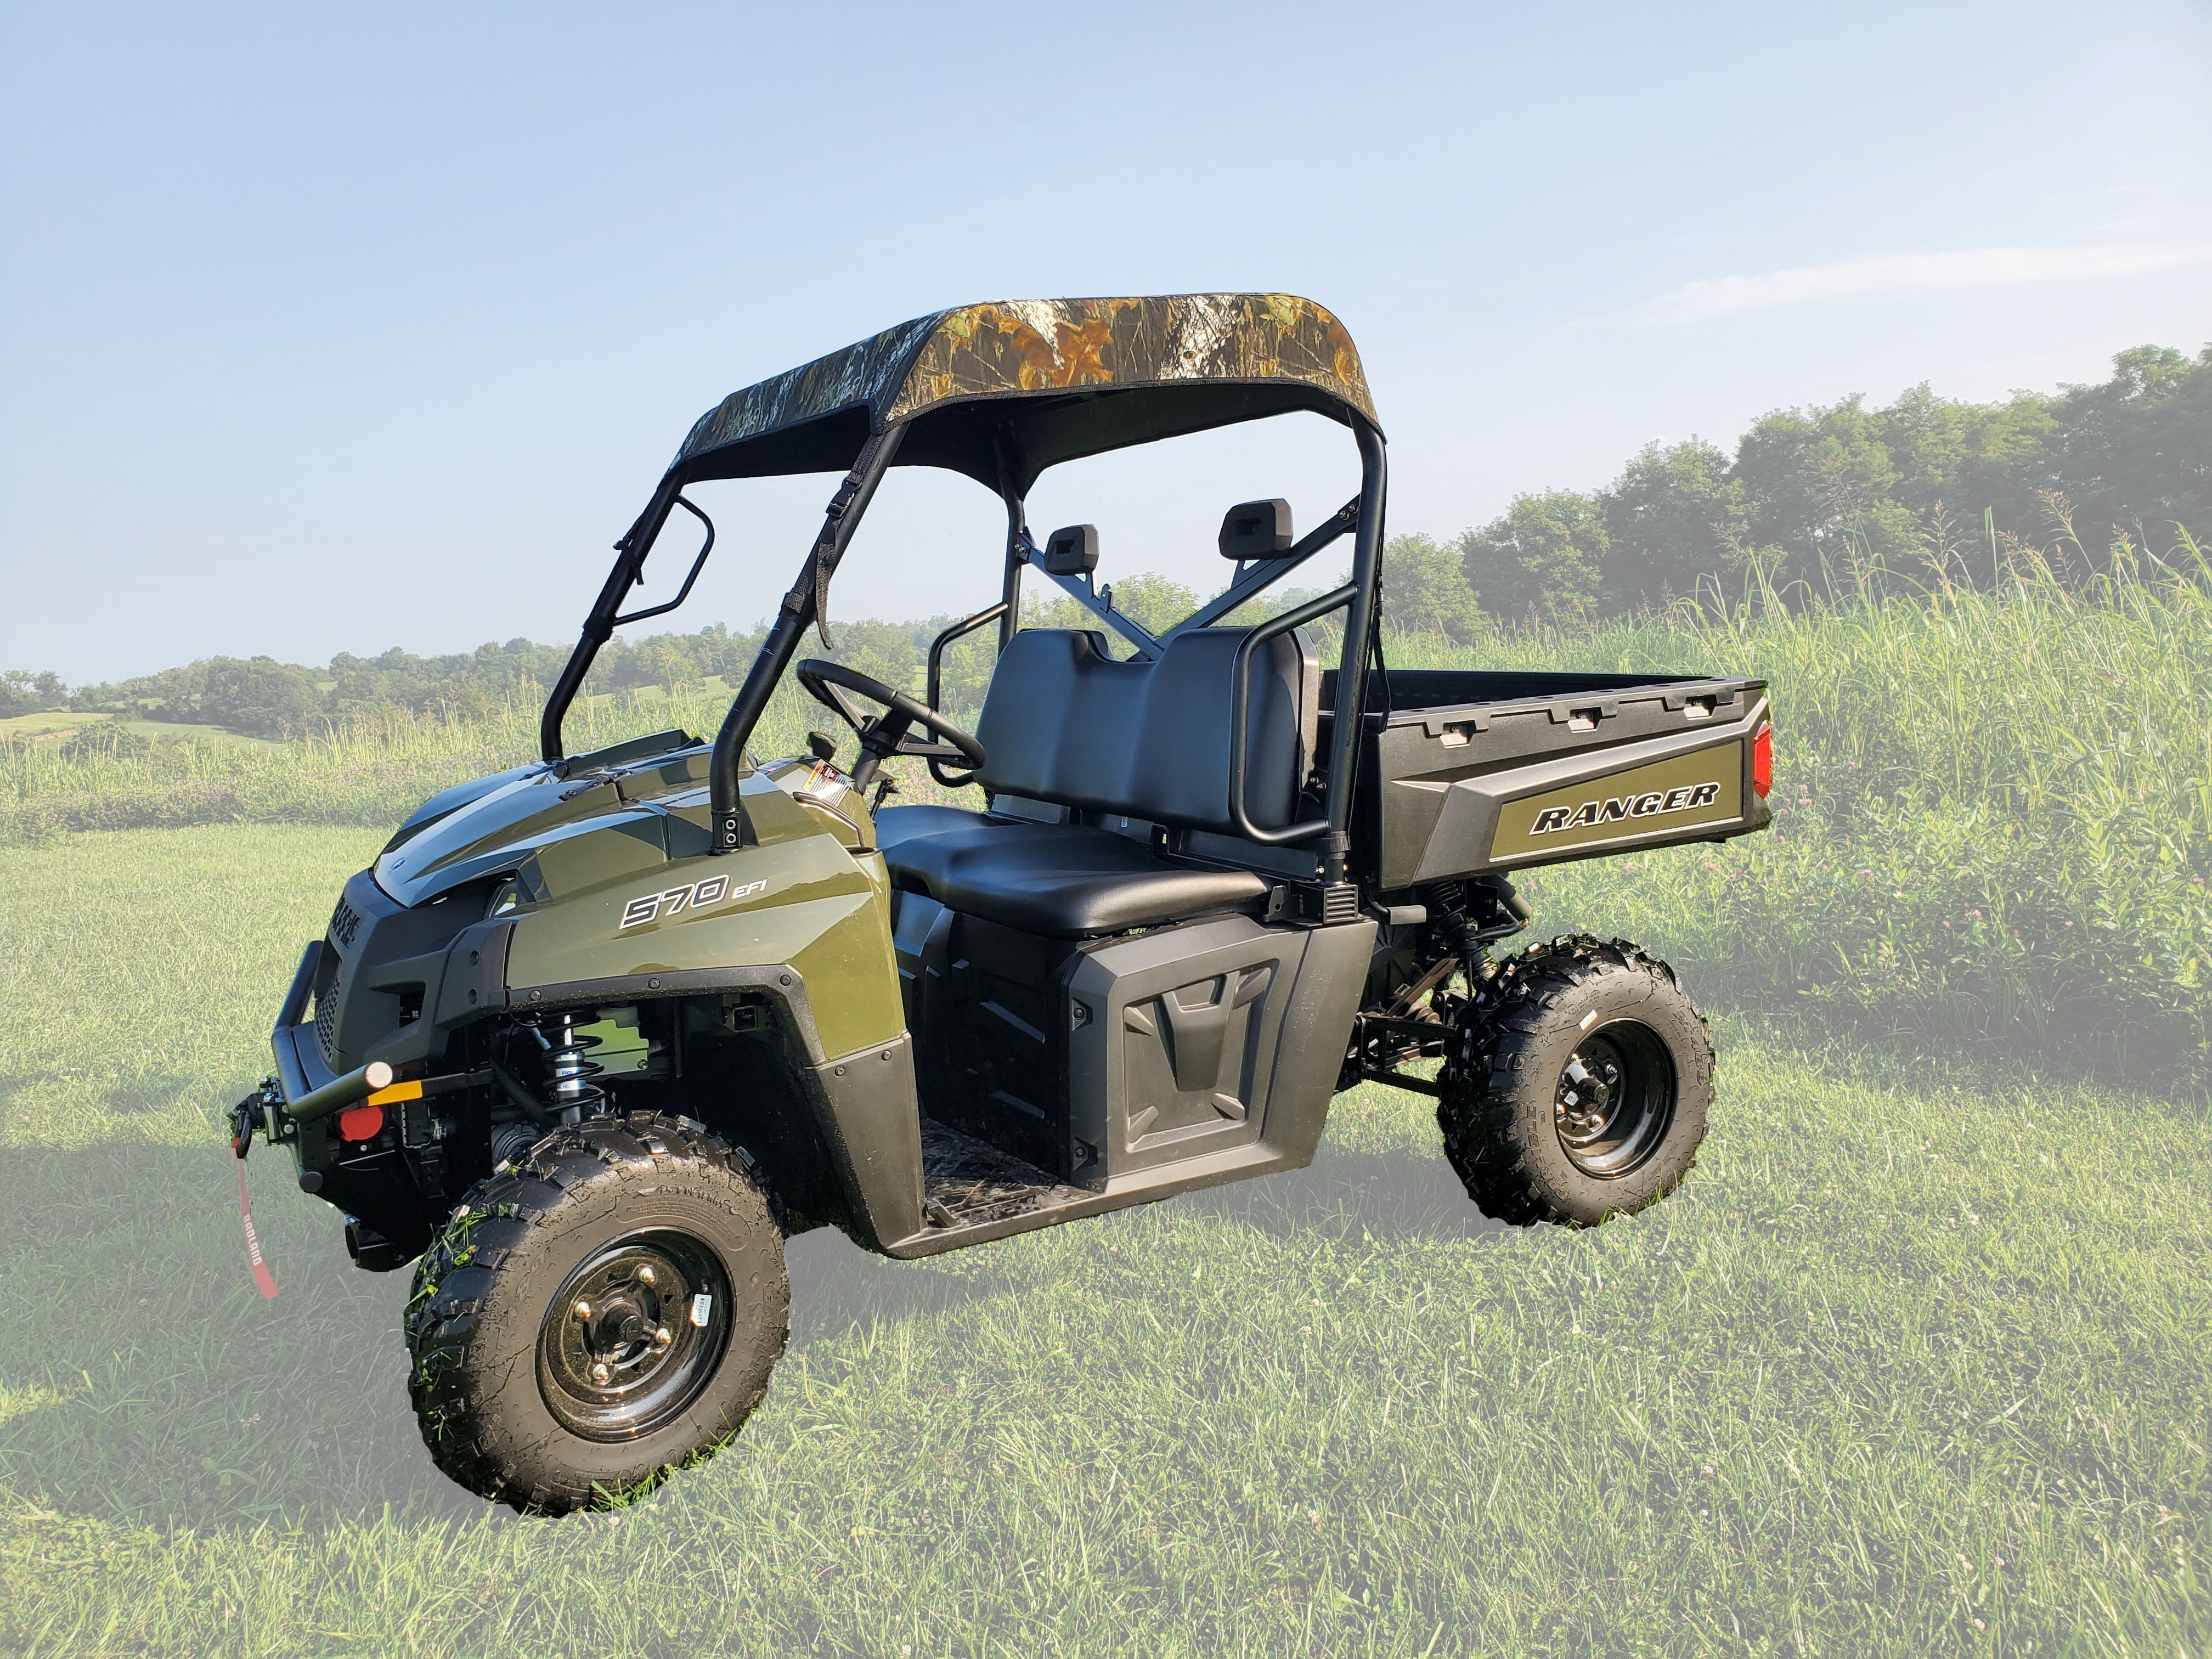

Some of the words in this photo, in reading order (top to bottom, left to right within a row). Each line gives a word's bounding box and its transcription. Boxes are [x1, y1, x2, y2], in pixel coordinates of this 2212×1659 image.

[1529, 782, 1720, 836] RANGER
[619, 874, 730, 929] 570
[731, 879, 768, 900] EFI
[243, 1214, 262, 1266] BADLAND
